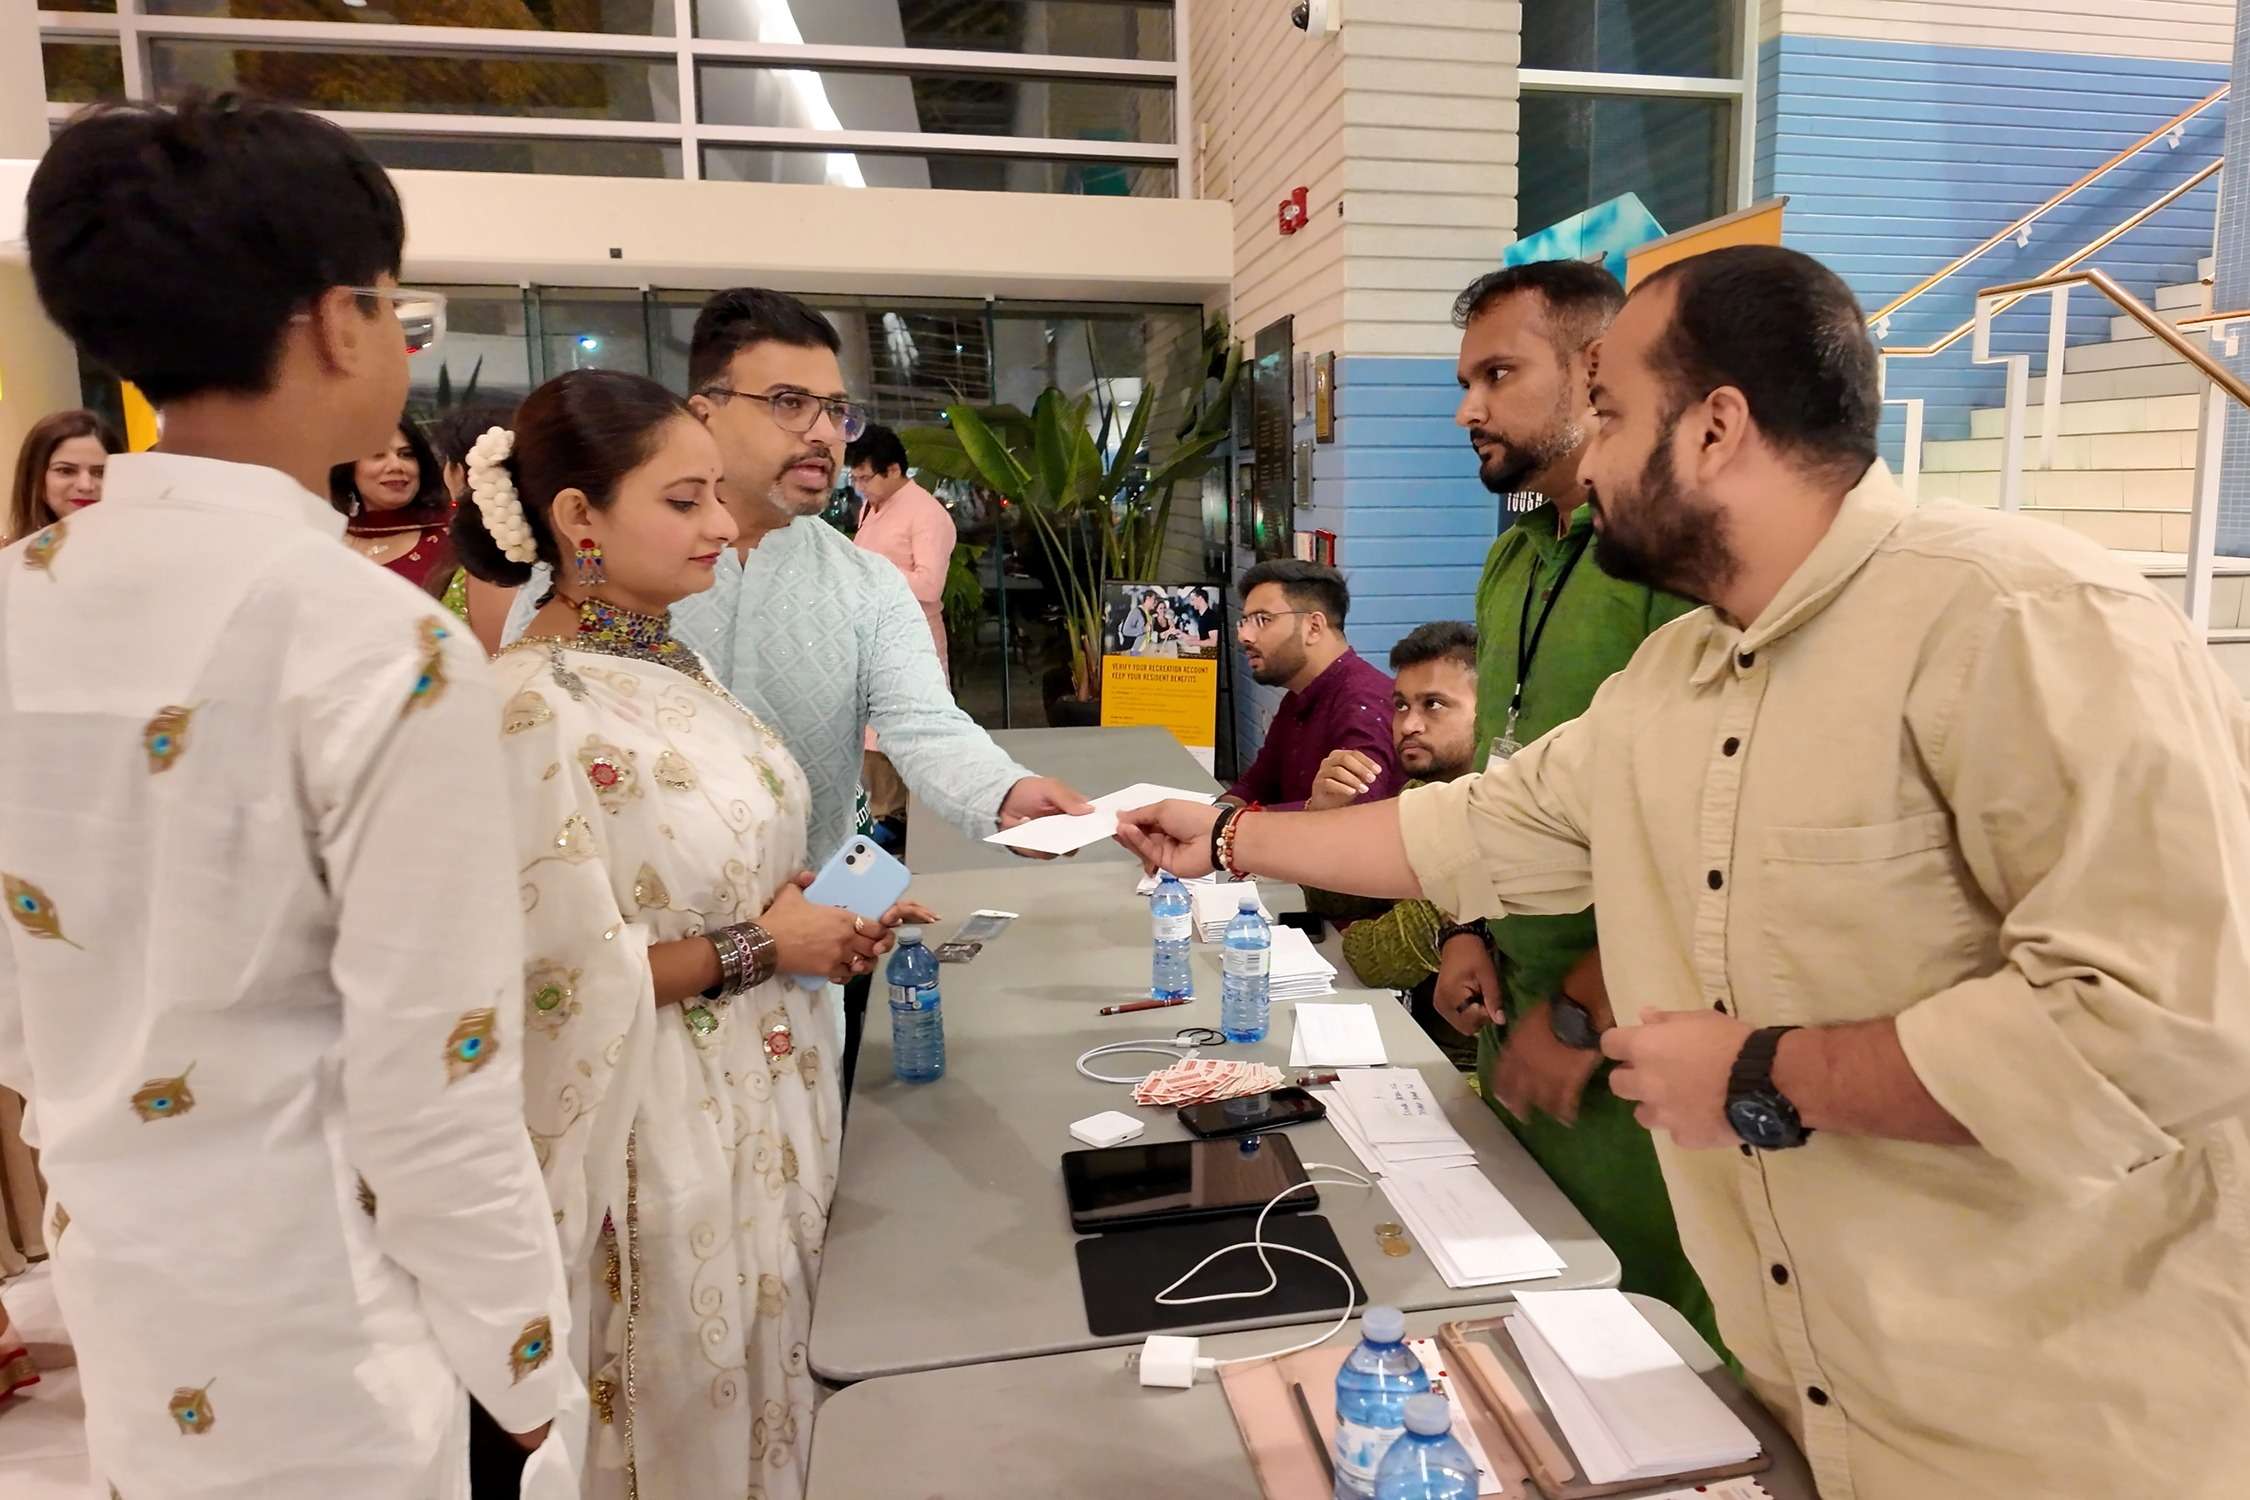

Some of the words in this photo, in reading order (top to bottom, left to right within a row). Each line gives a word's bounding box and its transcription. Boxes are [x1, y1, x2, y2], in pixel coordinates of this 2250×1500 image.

[1112, 663, 1131, 671] VERIFY
[1133, 664, 1147, 672] YOUR
[1149, 665, 1182, 673] RECREATION
[1183, 666, 1209, 674] ACCOUNT
[1112, 672, 1125, 680] KEEP
[1127, 673, 1141, 681] YOUR
[1143, 673, 1169, 682] RESIDENT
[1170, 675, 1197, 683] BENEFITS
